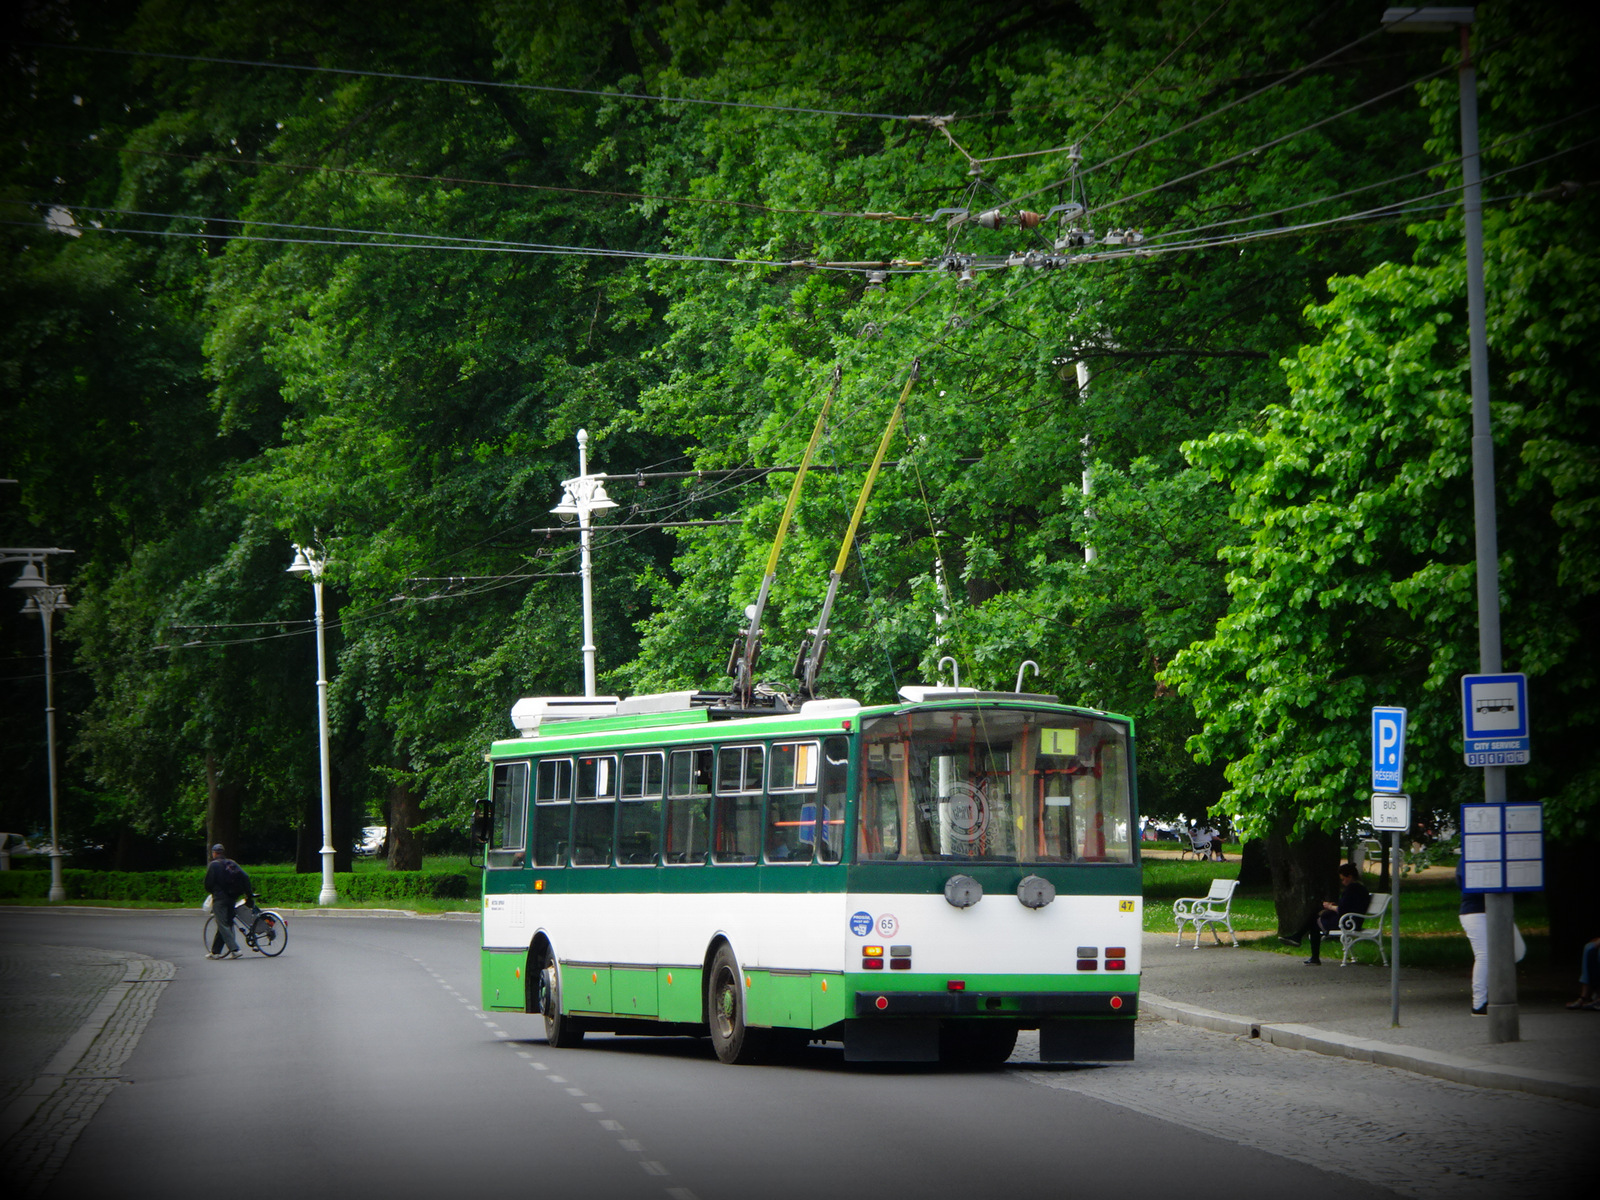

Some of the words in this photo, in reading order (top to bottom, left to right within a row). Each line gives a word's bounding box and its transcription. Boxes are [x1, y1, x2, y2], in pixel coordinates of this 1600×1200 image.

[1053, 731, 1062, 753] L
[1473, 742, 1490, 751] CITY
[1491, 741, 1521, 750] SERVICE
[1383, 801, 1396, 810] BUS
[1380, 814, 1384, 823] 5
[1386, 814, 1399, 823] min.
[1121, 901, 1133, 911] 47
[881, 919, 893, 930] 65
